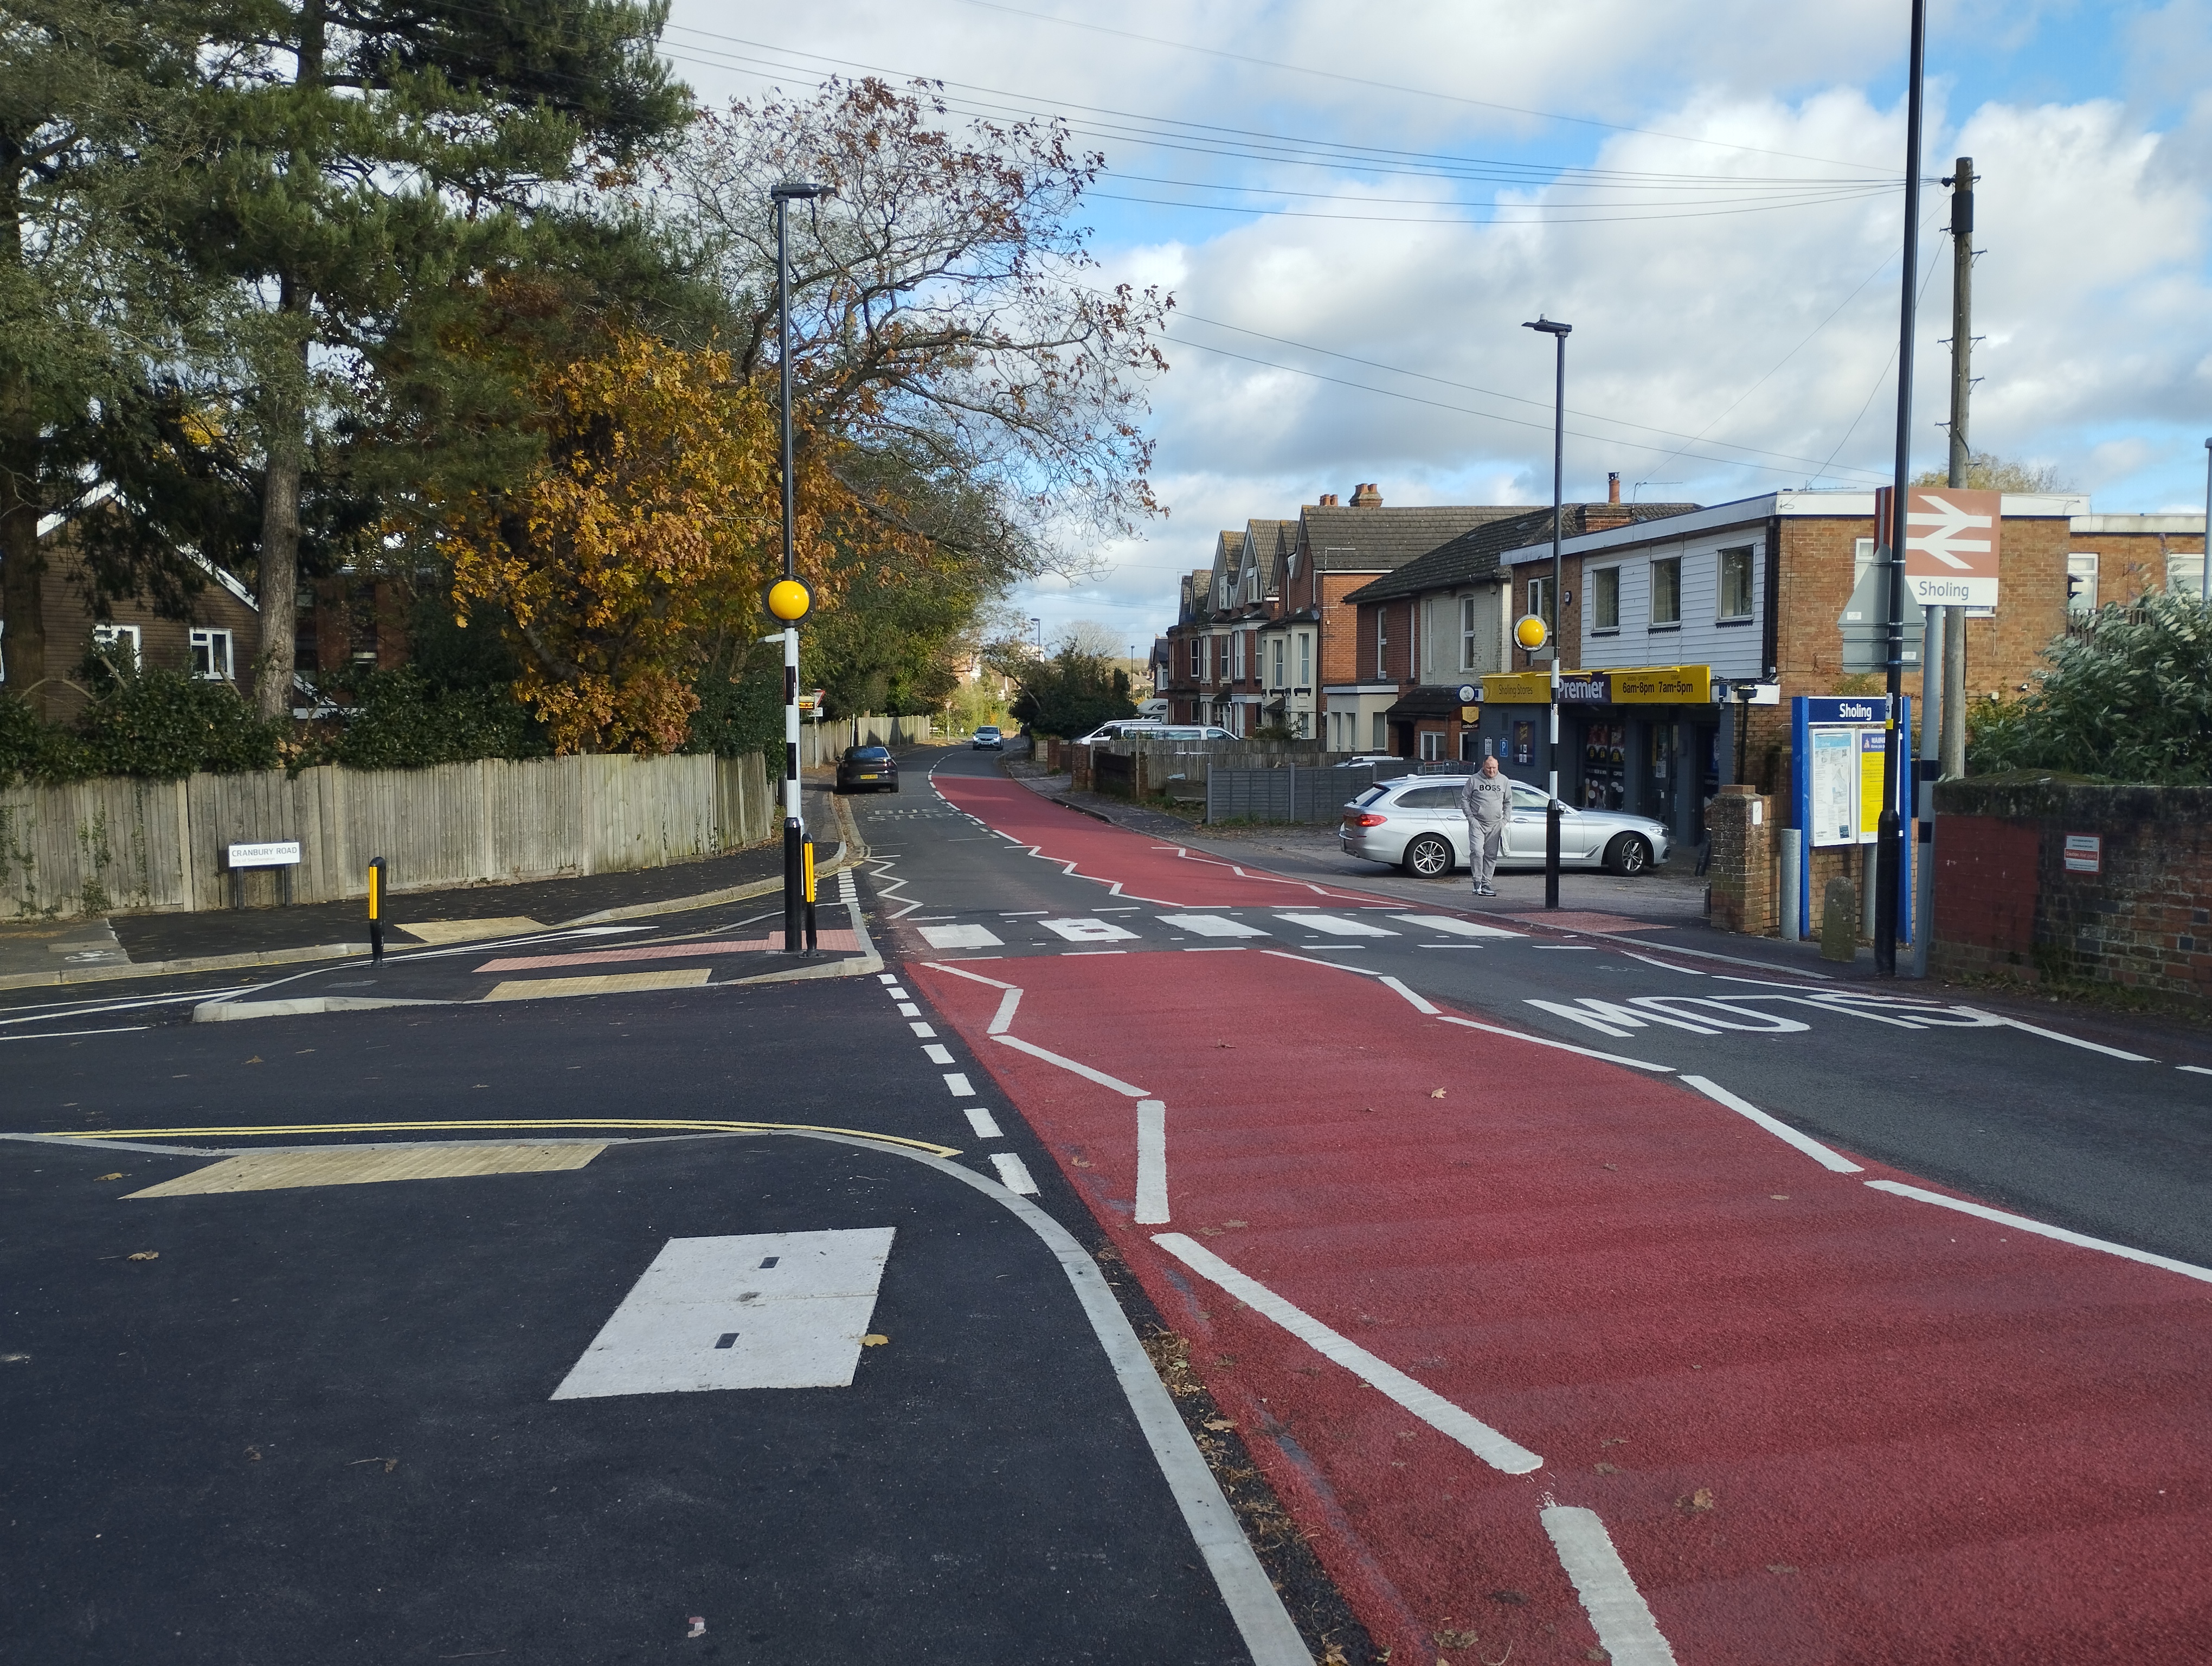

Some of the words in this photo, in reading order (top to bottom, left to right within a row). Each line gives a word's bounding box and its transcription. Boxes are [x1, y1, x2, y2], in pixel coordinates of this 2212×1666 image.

[1918, 581, 1969, 600] Sholing
[1499, 684, 1516, 698] Sholing
[1516, 684, 1533, 695] Stores
[1558, 678, 1604, 699] Premier
[1623, 681, 1655, 695] 6am-8pm
[1658, 681, 1694, 695] 7am-5pm
[1839, 703, 1872, 721] Sholing
[1502, 741, 1506, 752] P
[867, 813, 954, 822] STOP
[232, 848, 274, 857] CRANBURY
[276, 847, 297, 855] ROAD
